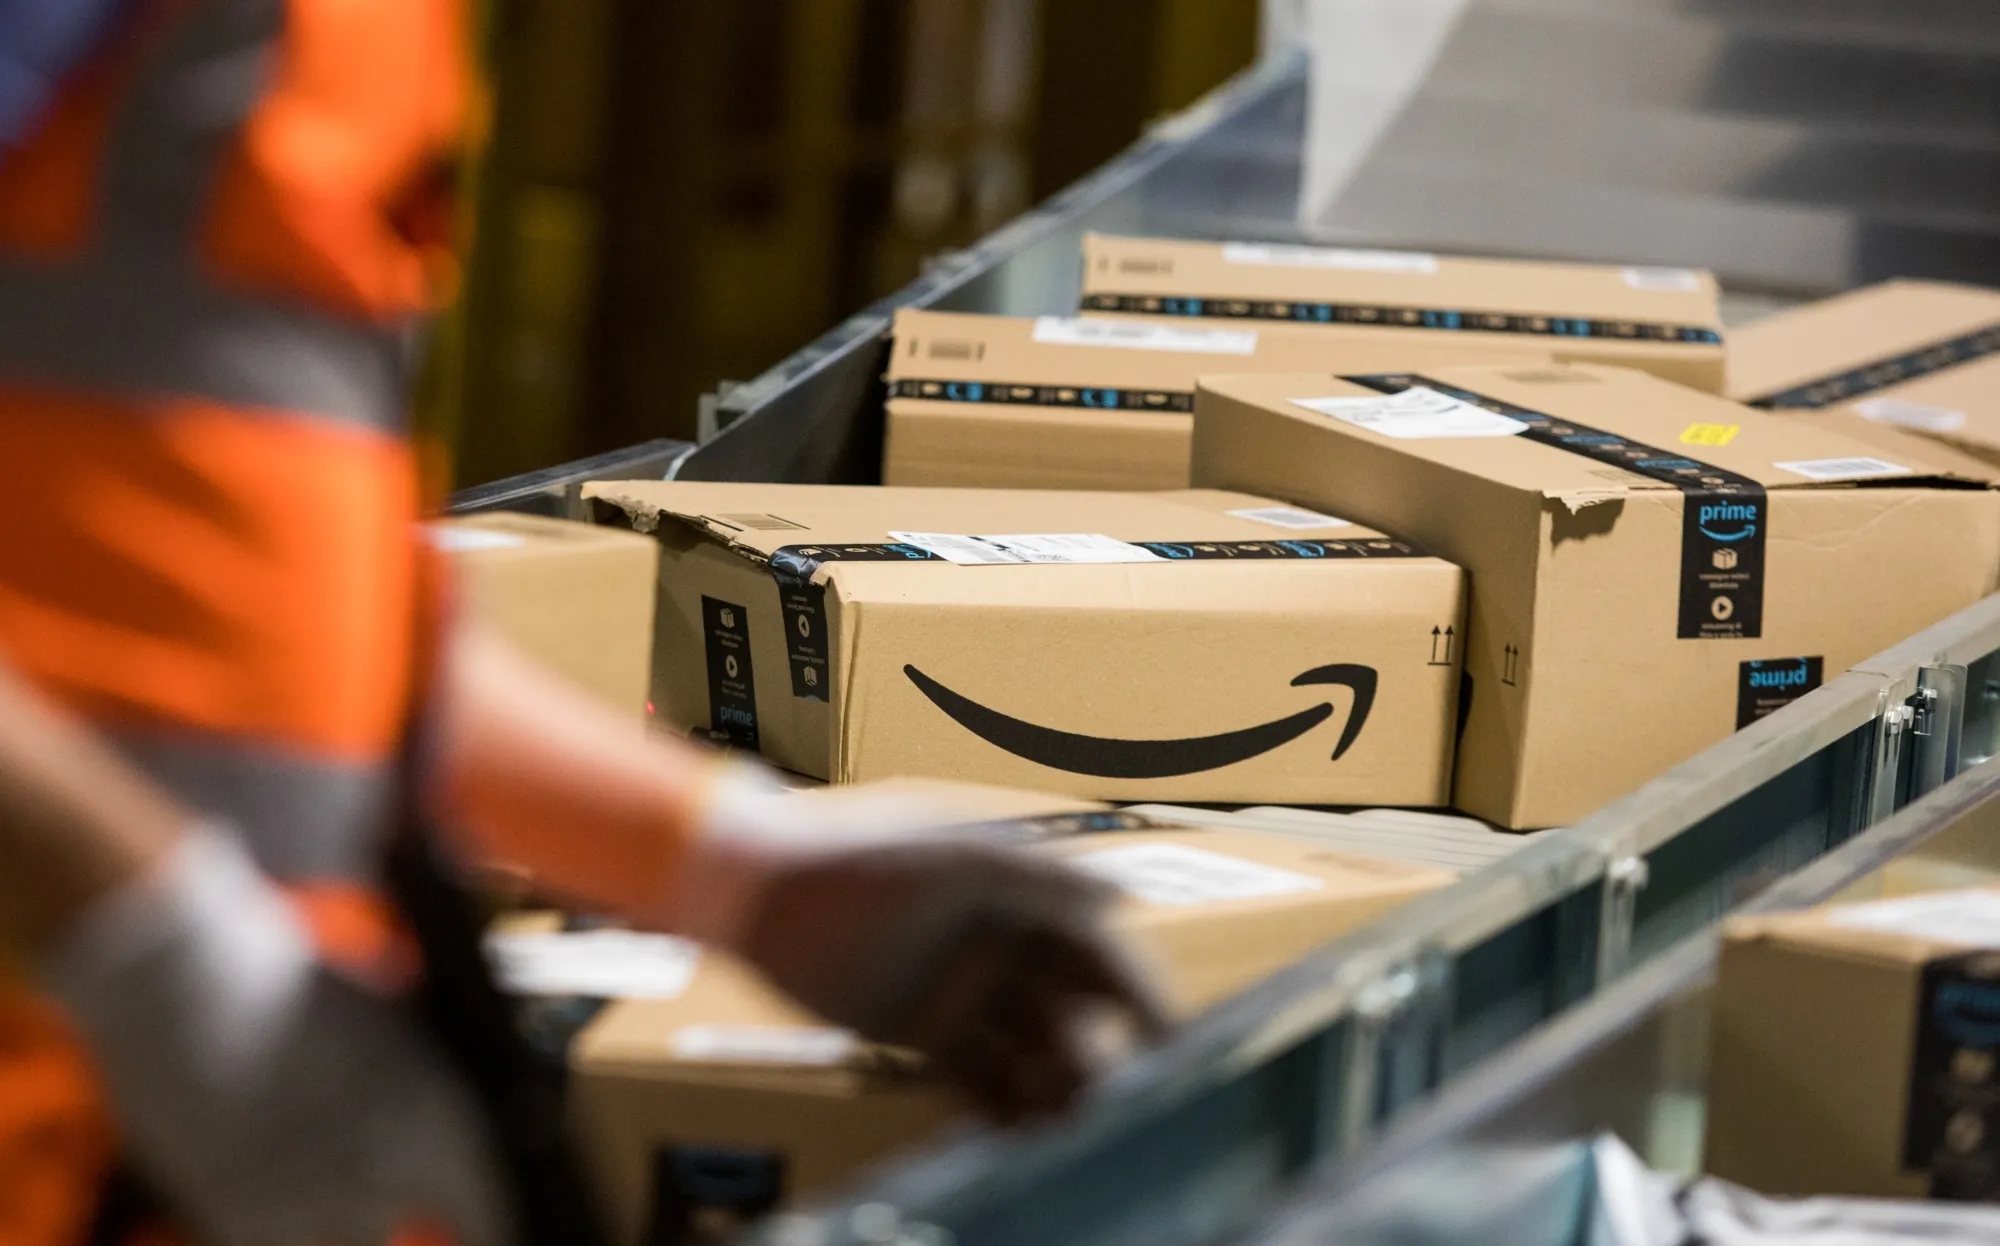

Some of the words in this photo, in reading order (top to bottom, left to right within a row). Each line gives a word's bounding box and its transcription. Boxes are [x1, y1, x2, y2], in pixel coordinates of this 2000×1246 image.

[1700, 500, 1757, 525] prime
[1749, 664, 1807, 691] prime
[720, 704, 753, 726] prime
